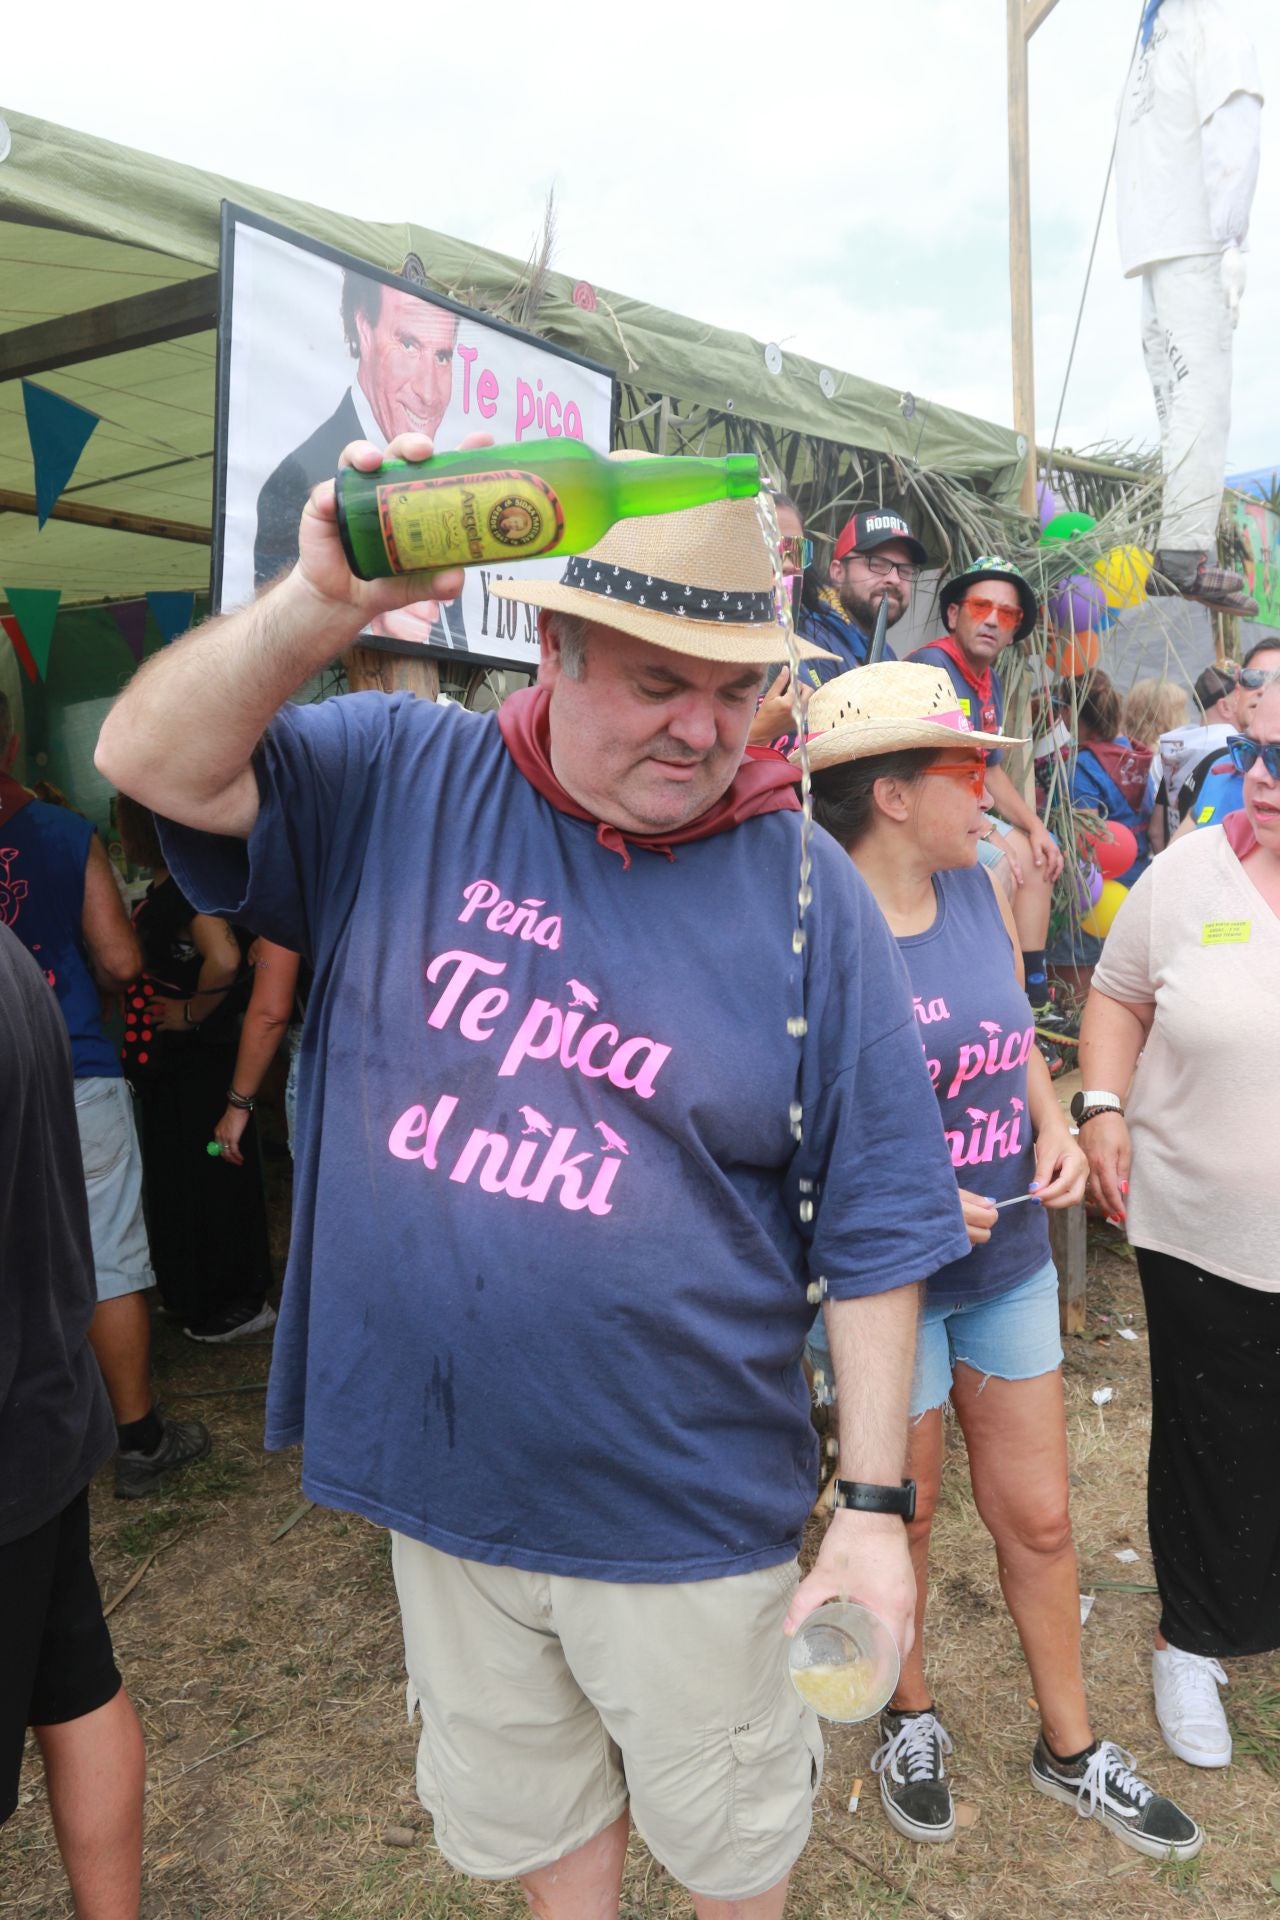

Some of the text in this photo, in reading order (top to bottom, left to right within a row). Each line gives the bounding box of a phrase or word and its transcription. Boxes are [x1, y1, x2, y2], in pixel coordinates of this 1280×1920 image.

[457, 343, 584, 442] Te pica
[515, 498, 536, 516] SIDRA
[480, 570, 490, 636] Y
[458, 879, 562, 950] Peña
[426, 950, 672, 1099] Te pica
[913, 996, 950, 1025] ña
[388, 1094, 629, 1216] el niki
